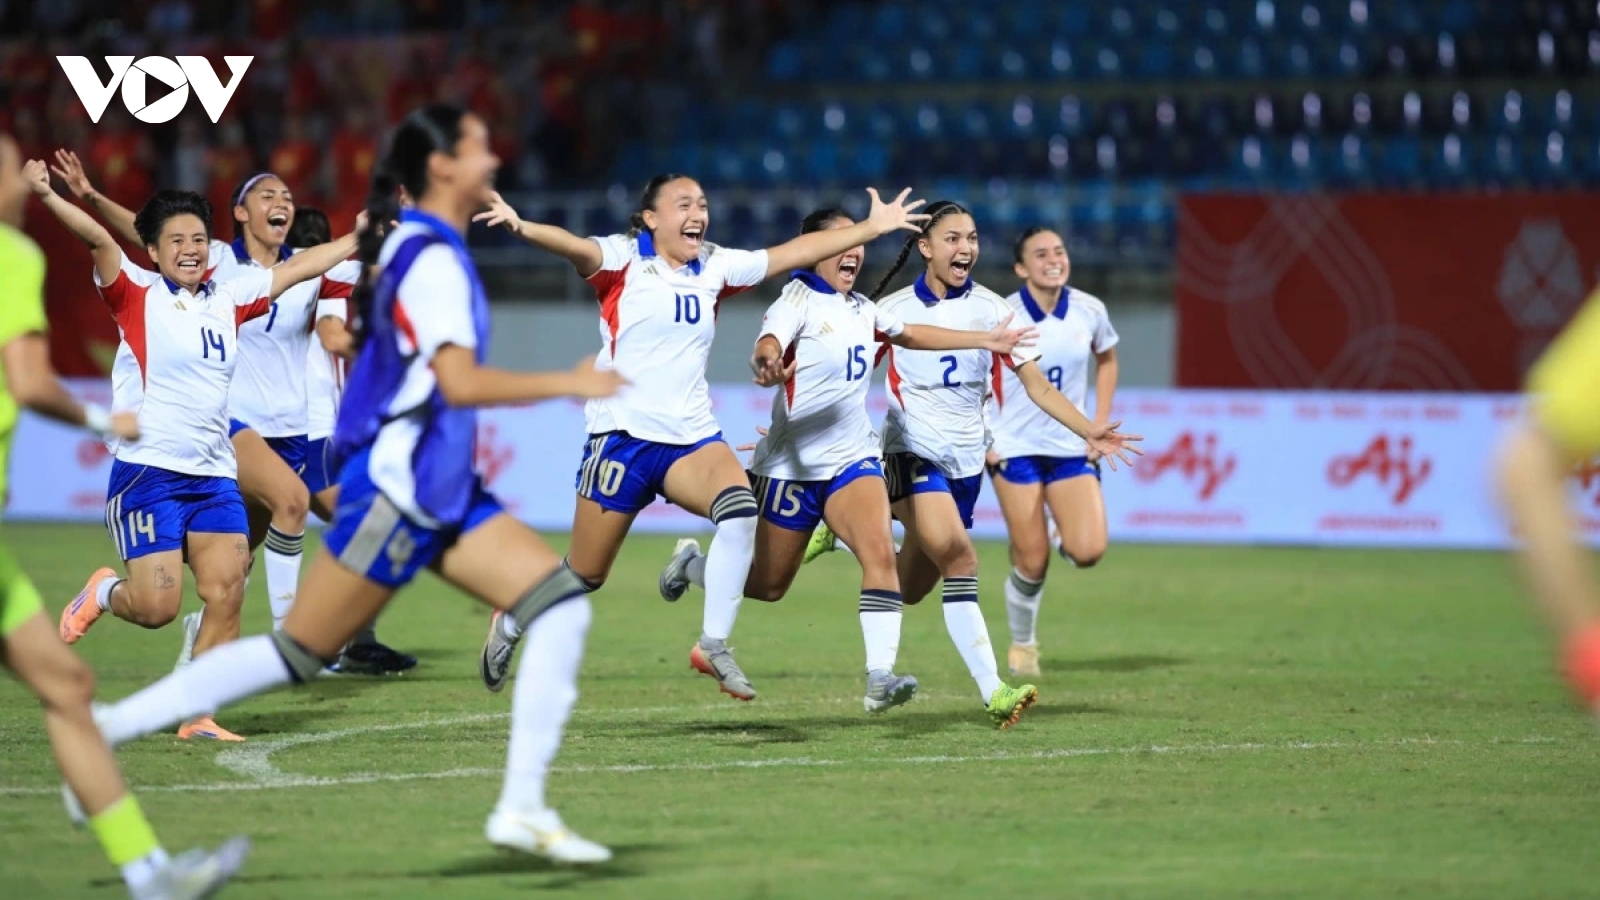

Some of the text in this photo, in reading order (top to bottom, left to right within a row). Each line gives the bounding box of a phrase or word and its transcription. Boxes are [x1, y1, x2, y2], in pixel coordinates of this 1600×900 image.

[674, 293, 700, 324] 10
[201, 327, 226, 361] 14
[846, 345, 866, 381] 15
[940, 355, 960, 386] 2
[1048, 366, 1062, 391] 9
[599, 459, 625, 496] 10
[771, 480, 804, 517] 15
[129, 510, 156, 547] 14
